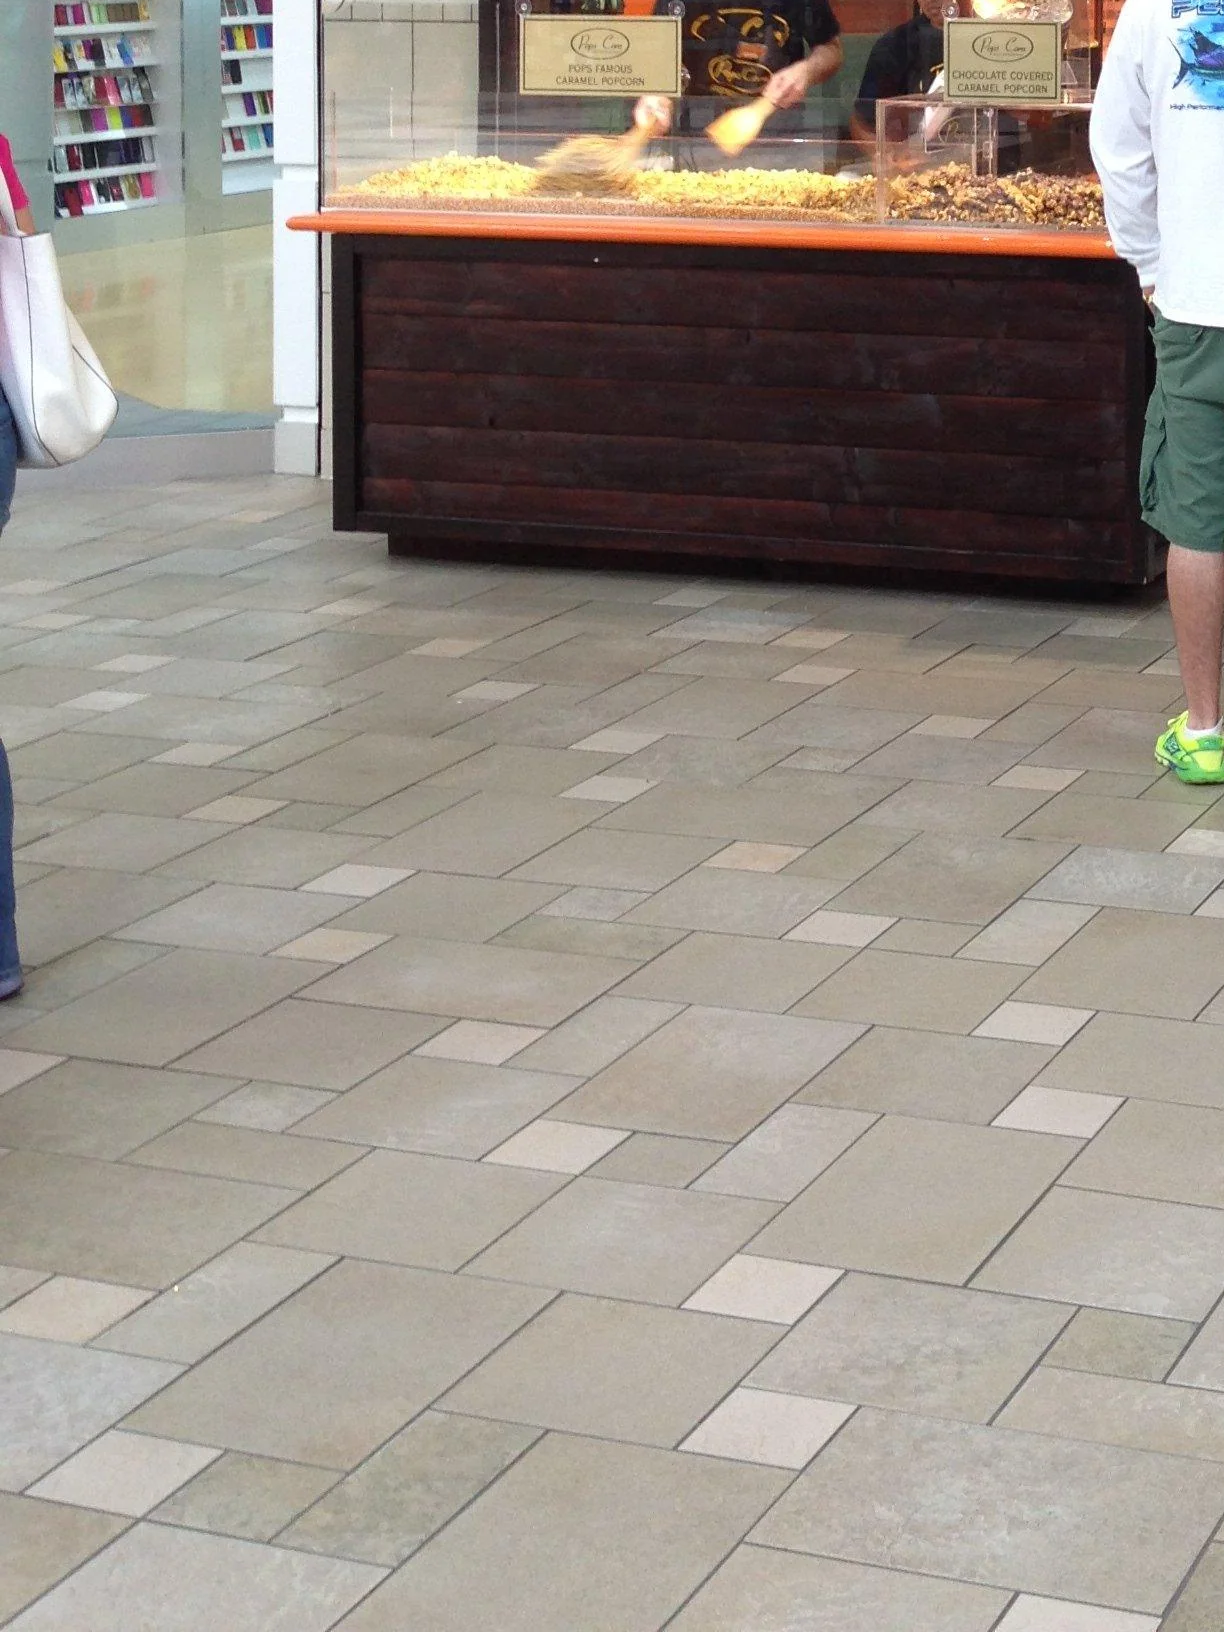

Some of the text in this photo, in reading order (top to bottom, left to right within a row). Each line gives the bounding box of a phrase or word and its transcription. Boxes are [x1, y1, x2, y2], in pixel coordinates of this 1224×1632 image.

[568, 64, 633, 74] POPS FAMOUS
[555, 76, 645, 87] CARAMEL POPCORN
[951, 70, 1054, 82] CHOCOLATE COVERED
[957, 83, 1049, 94] CARAMEL POPCORN
